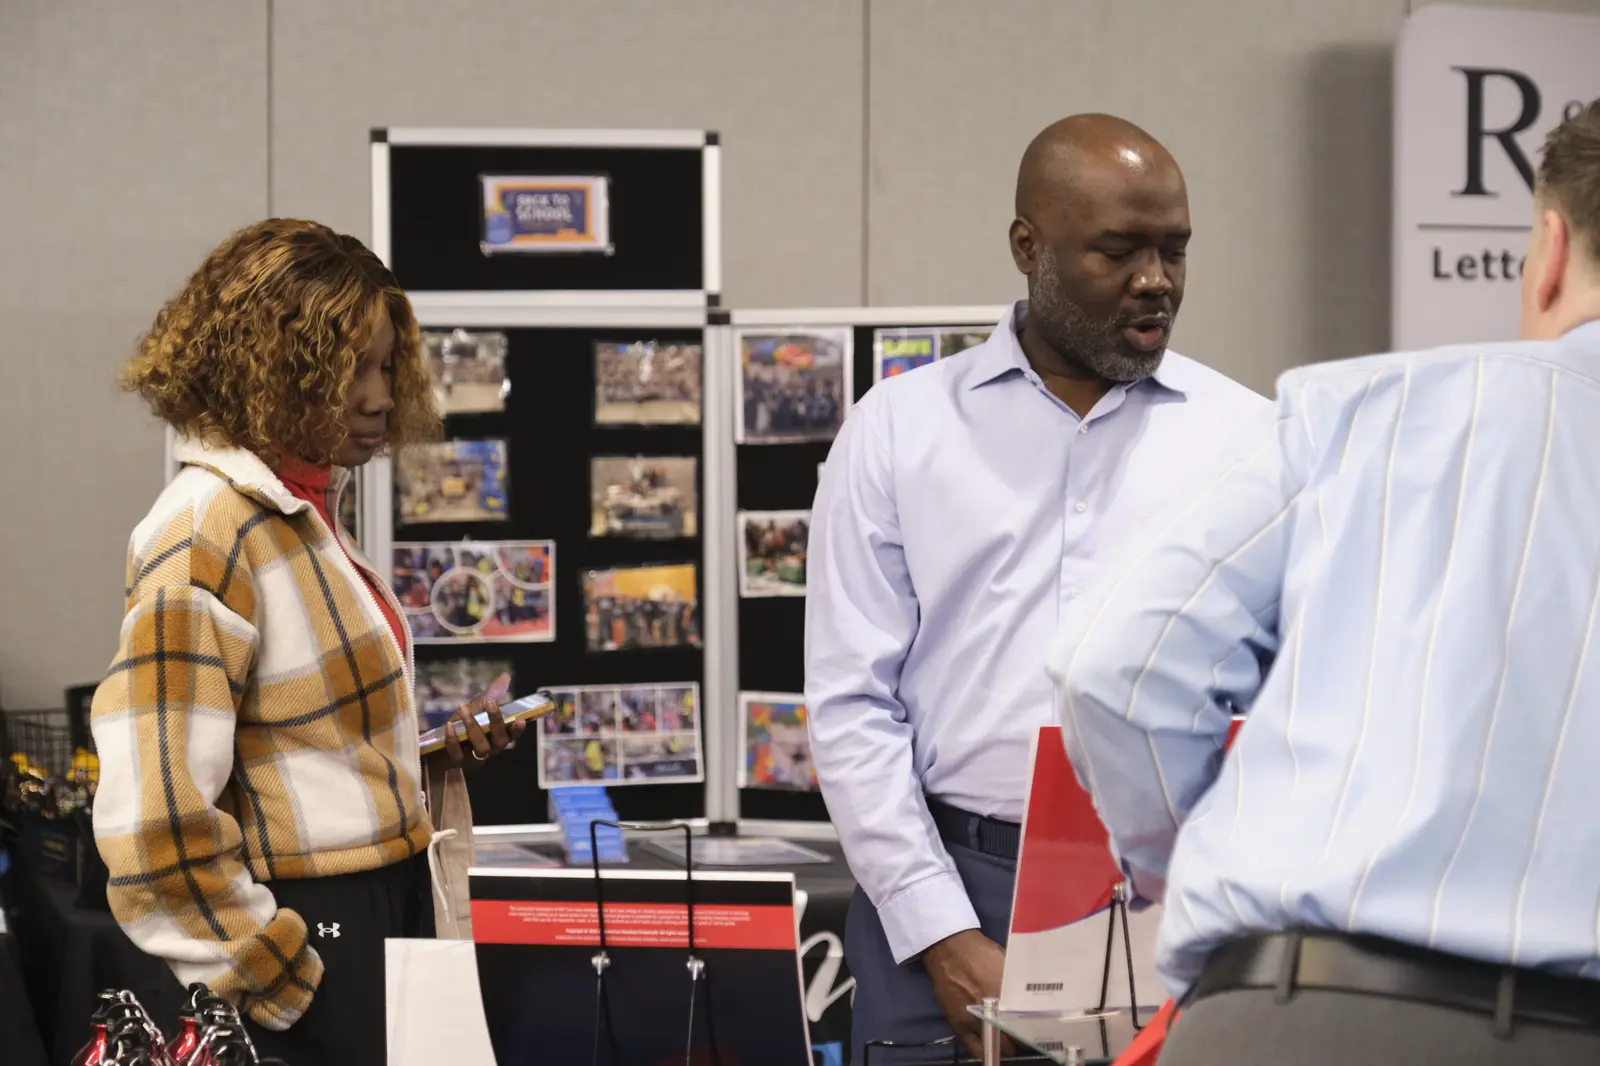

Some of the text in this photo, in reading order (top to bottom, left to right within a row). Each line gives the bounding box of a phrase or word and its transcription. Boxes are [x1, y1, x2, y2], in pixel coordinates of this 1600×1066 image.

[1449, 65, 1542, 197] R
[515, 205, 574, 223] SCHOOL
[1432, 246, 1527, 281] Lett
